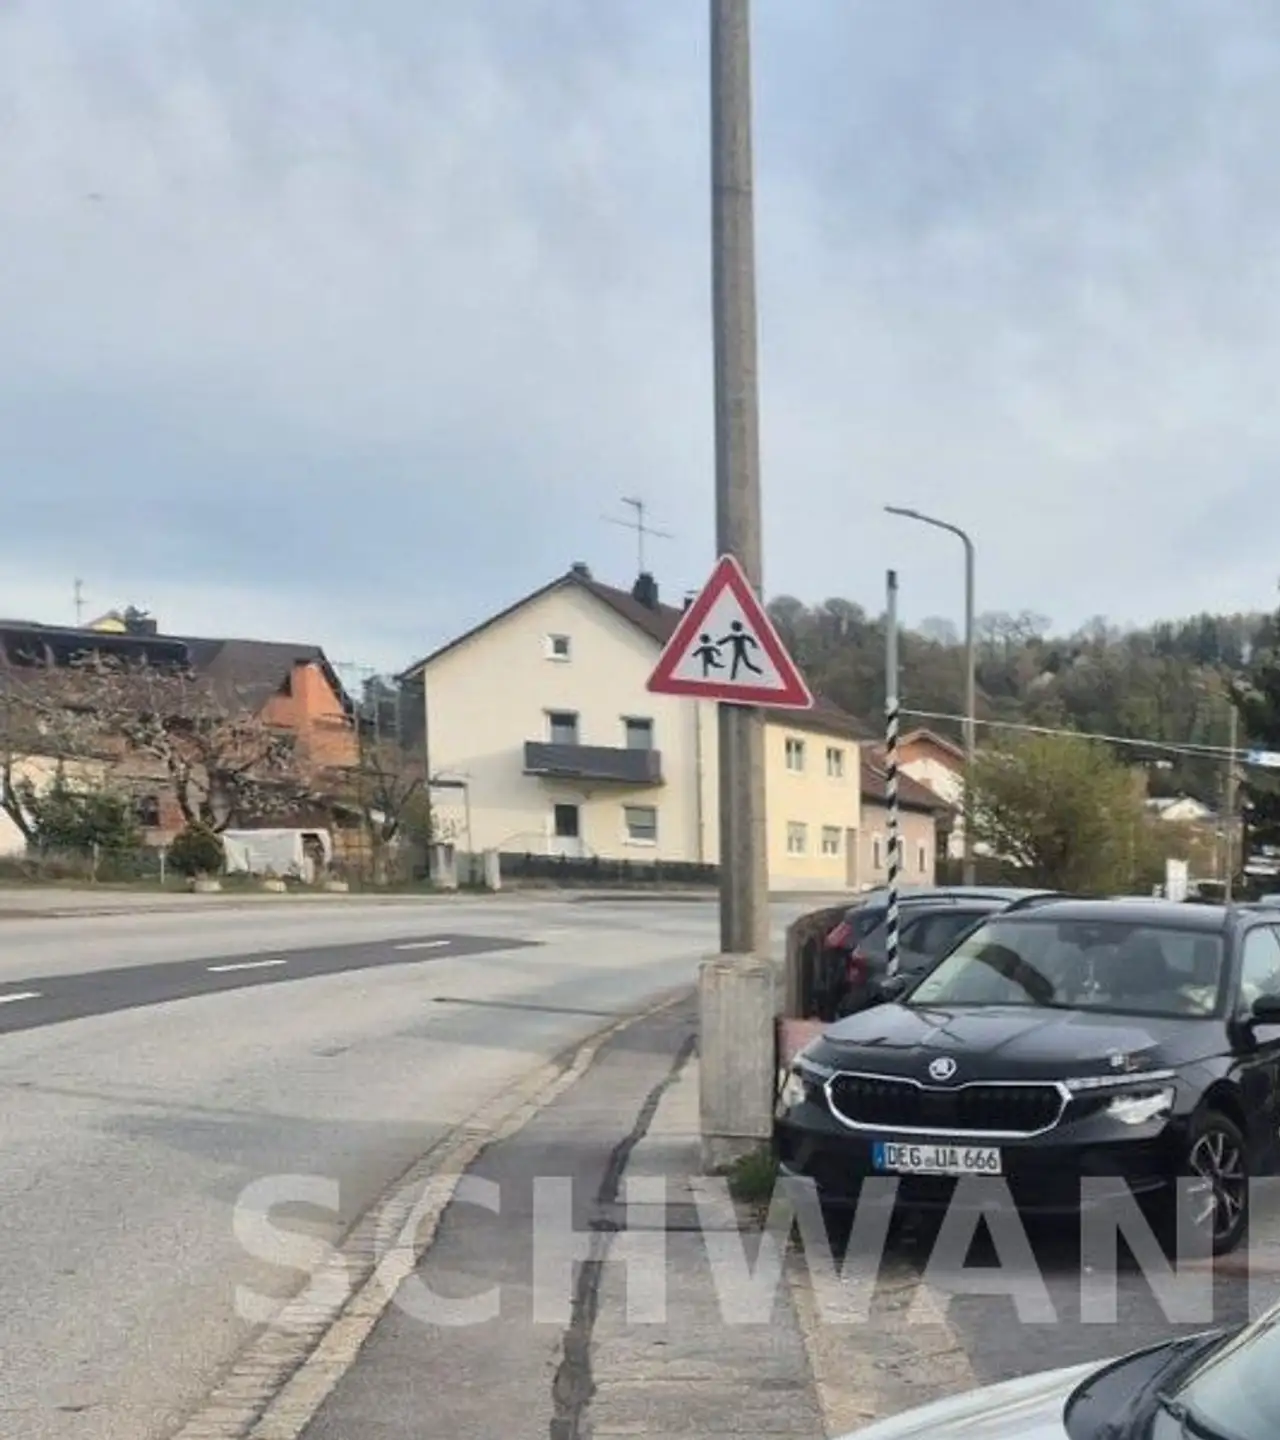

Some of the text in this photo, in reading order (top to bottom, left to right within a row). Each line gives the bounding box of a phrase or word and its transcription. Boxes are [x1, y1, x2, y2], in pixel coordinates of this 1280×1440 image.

[886, 1145, 998, 1171] DEG UA 666
